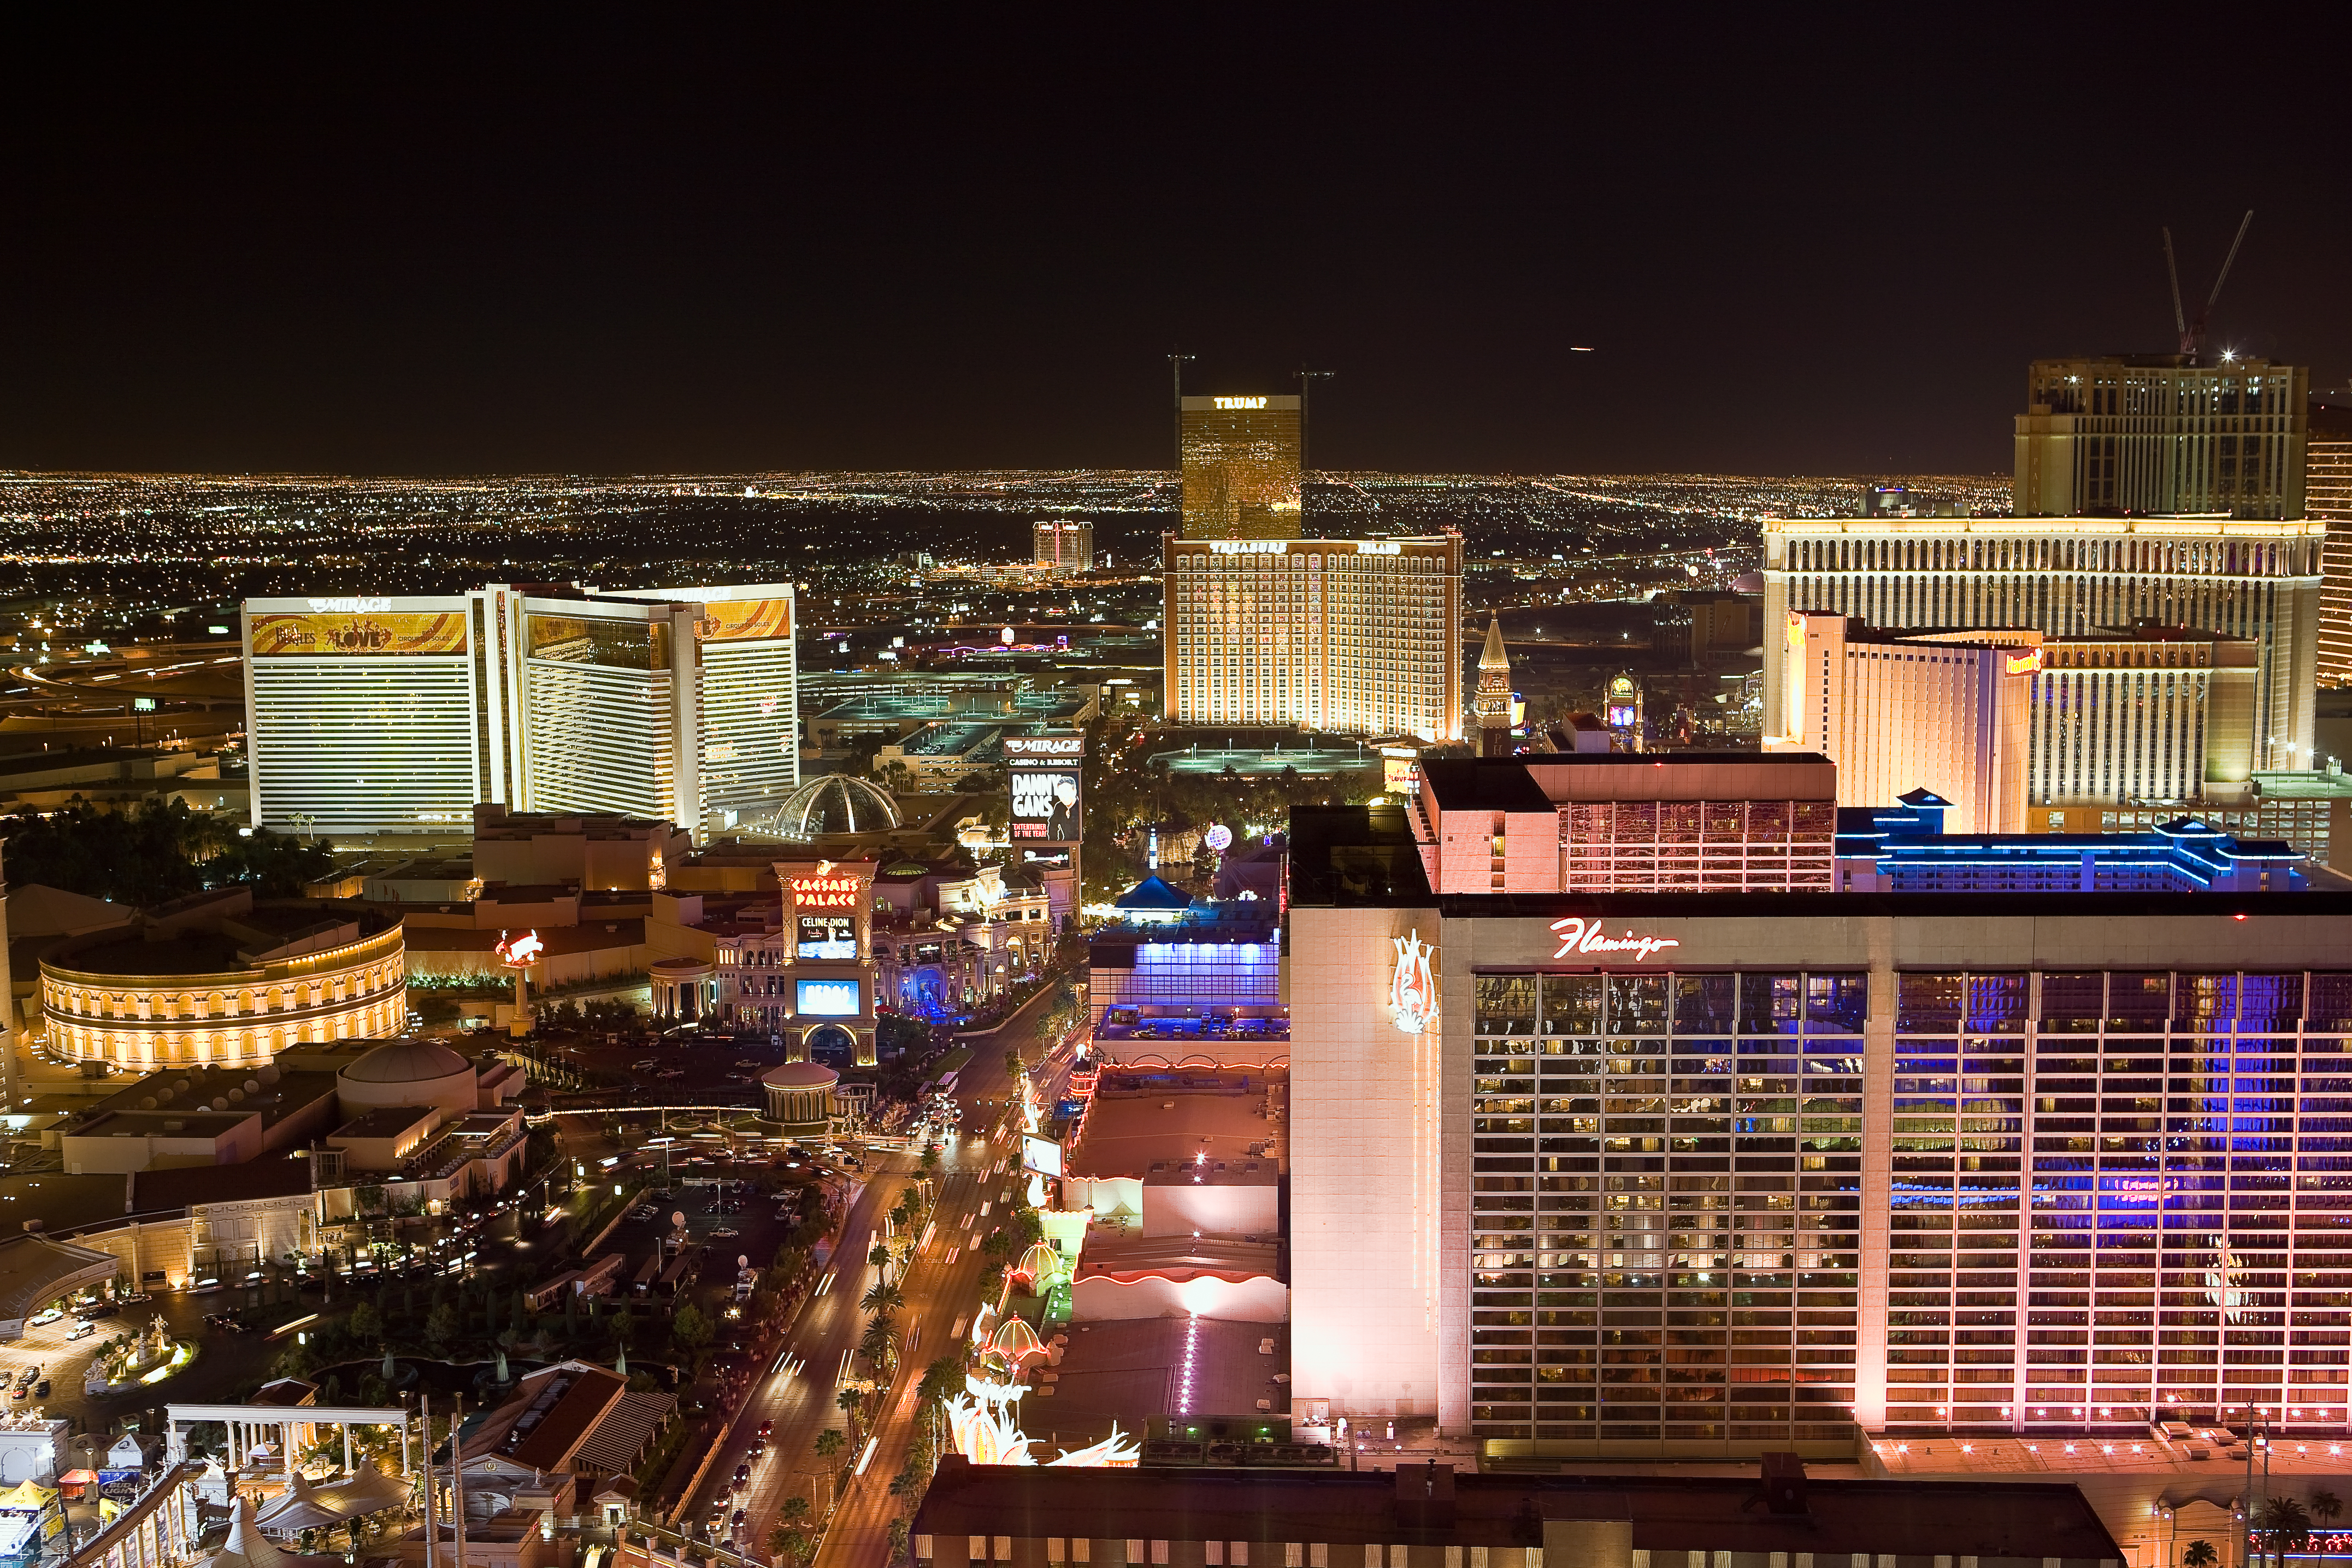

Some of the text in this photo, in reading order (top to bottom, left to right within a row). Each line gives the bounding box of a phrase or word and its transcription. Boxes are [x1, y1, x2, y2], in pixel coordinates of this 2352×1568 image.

[1214, 397, 1267, 409] TRUMP
[1209, 542, 1401, 555] TREASURE ISLAND
[669, 587, 732, 603] MIRAGE
[316, 598, 391, 614] MIRAGE
[335, 632, 381, 648] LOVE
[1012, 740, 1081, 754] MIRAGE
[1012, 774, 1062, 795] DANNY
[1012, 795, 1054, 817] GANS
[792, 879, 858, 892] CAESARS
[796, 893, 856, 906] PALACE
[802, 918, 849, 927] CELINE DION
[1549, 917, 1679, 961] Flamingo
